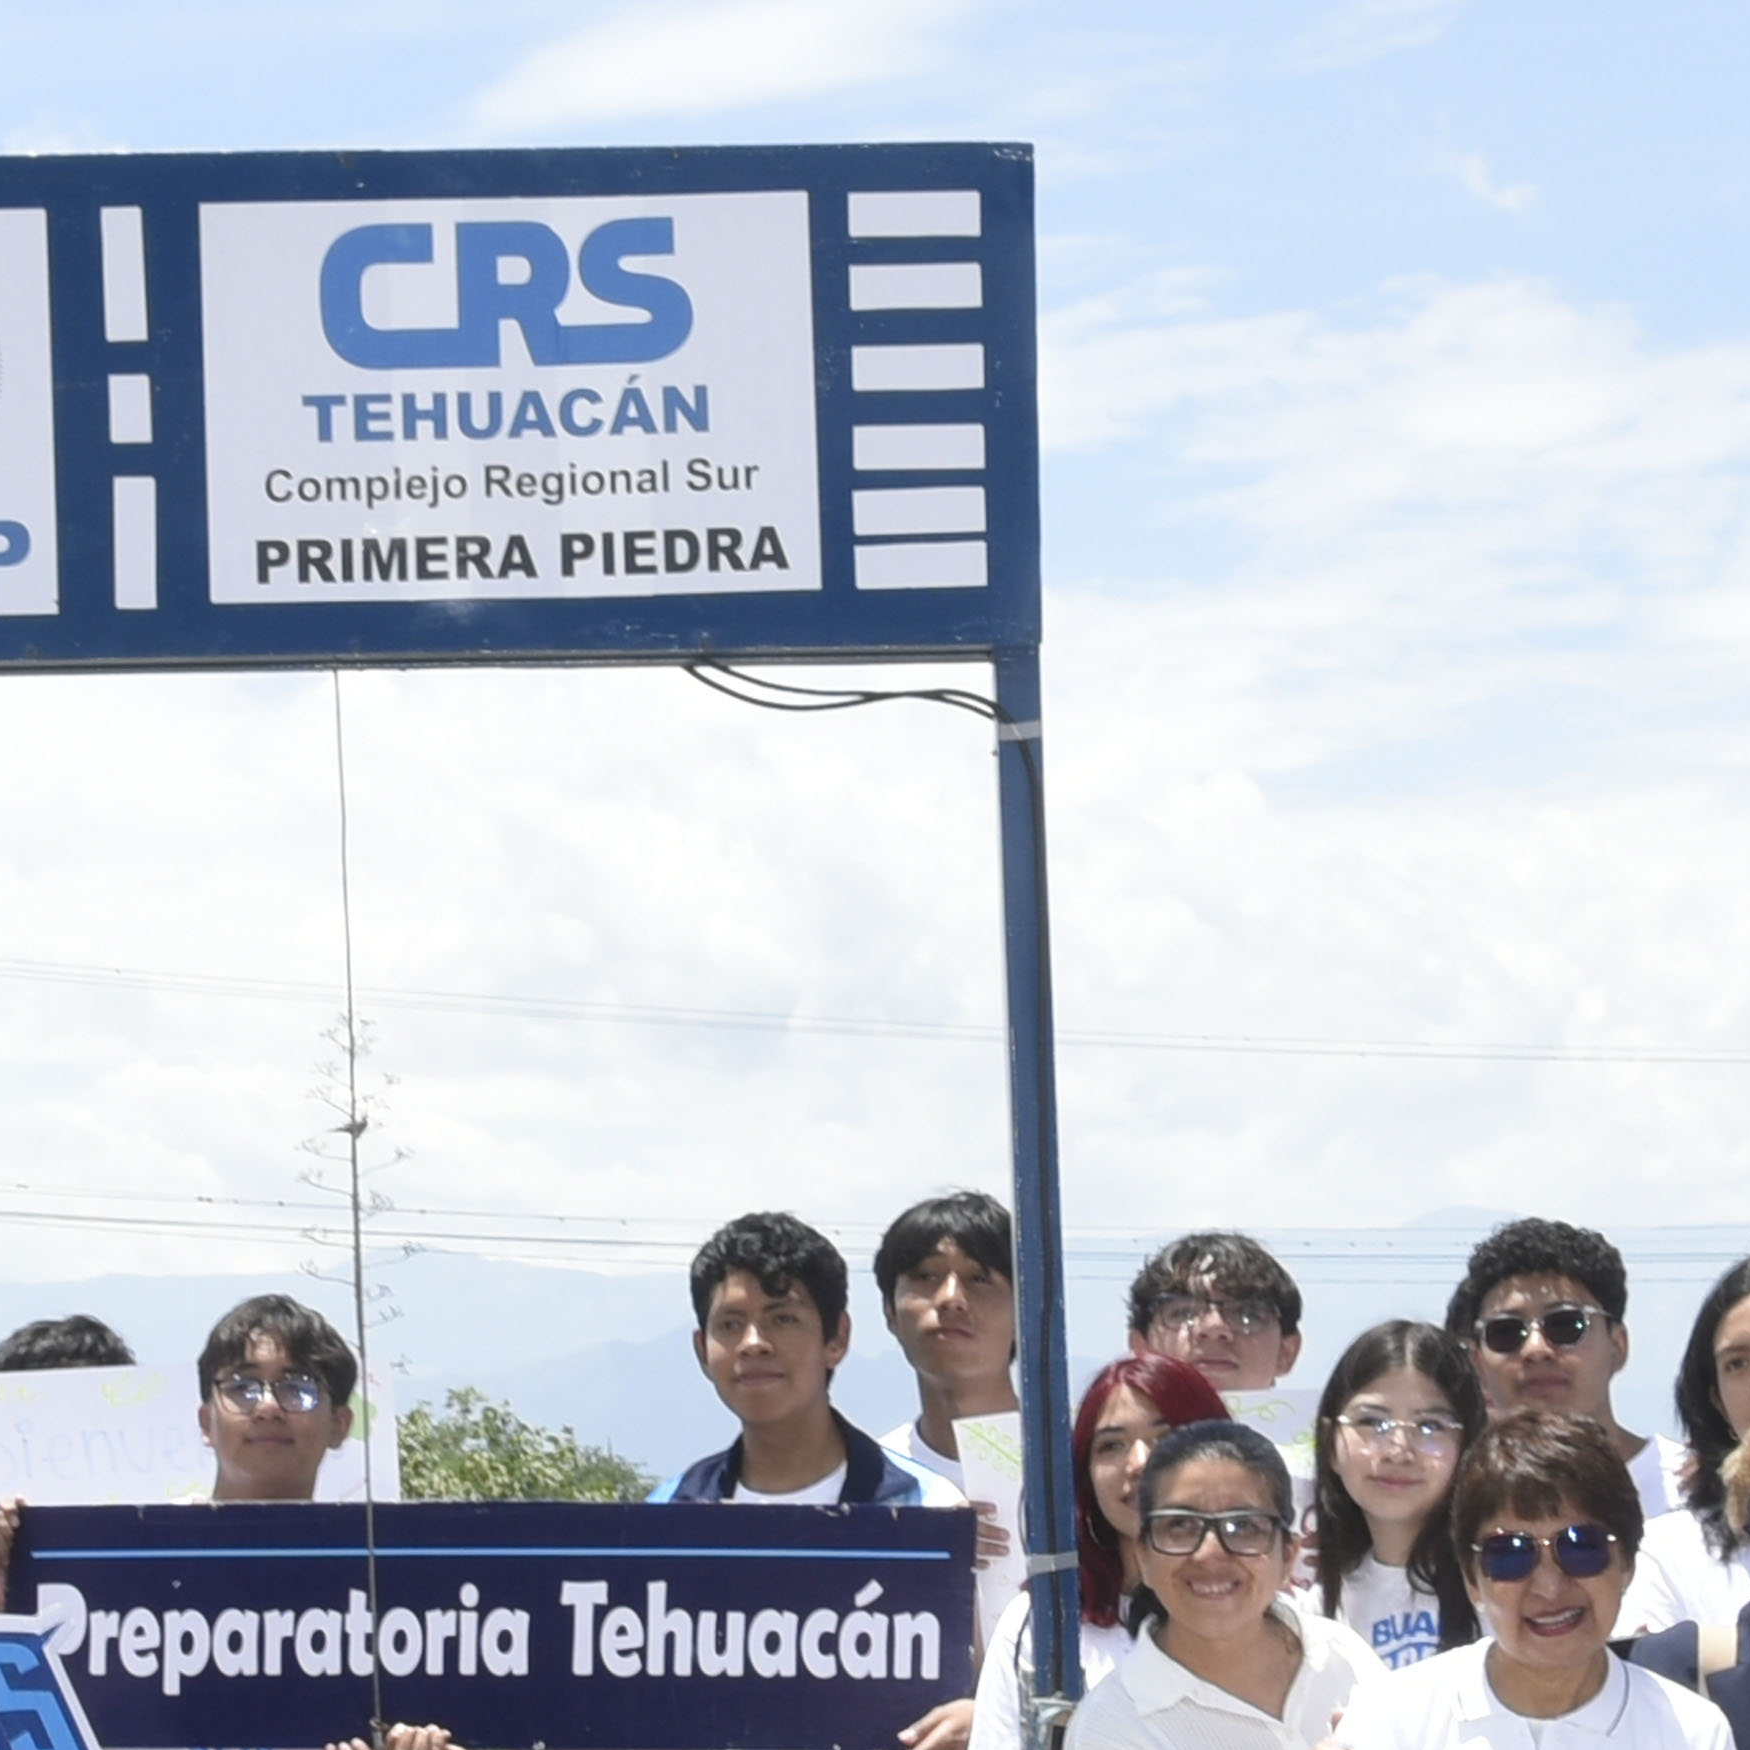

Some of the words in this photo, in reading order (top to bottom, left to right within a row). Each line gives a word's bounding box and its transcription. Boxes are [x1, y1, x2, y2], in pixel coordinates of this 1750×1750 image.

[319, 216, 694, 371] CRS
[302, 374, 710, 443] TEHUACÁN
[265, 466, 468, 509] Complejo
[484, 461, 671, 505] Regional
[686, 458, 760, 492] Sur
[255, 534, 538, 585] PRIMERA
[560, 525, 791, 577] PIEDRA
[37, 1582, 530, 1696] Preparatoria
[560, 1579, 940, 1680] Tehuacán
[1373, 1611, 1441, 1648] BUA
